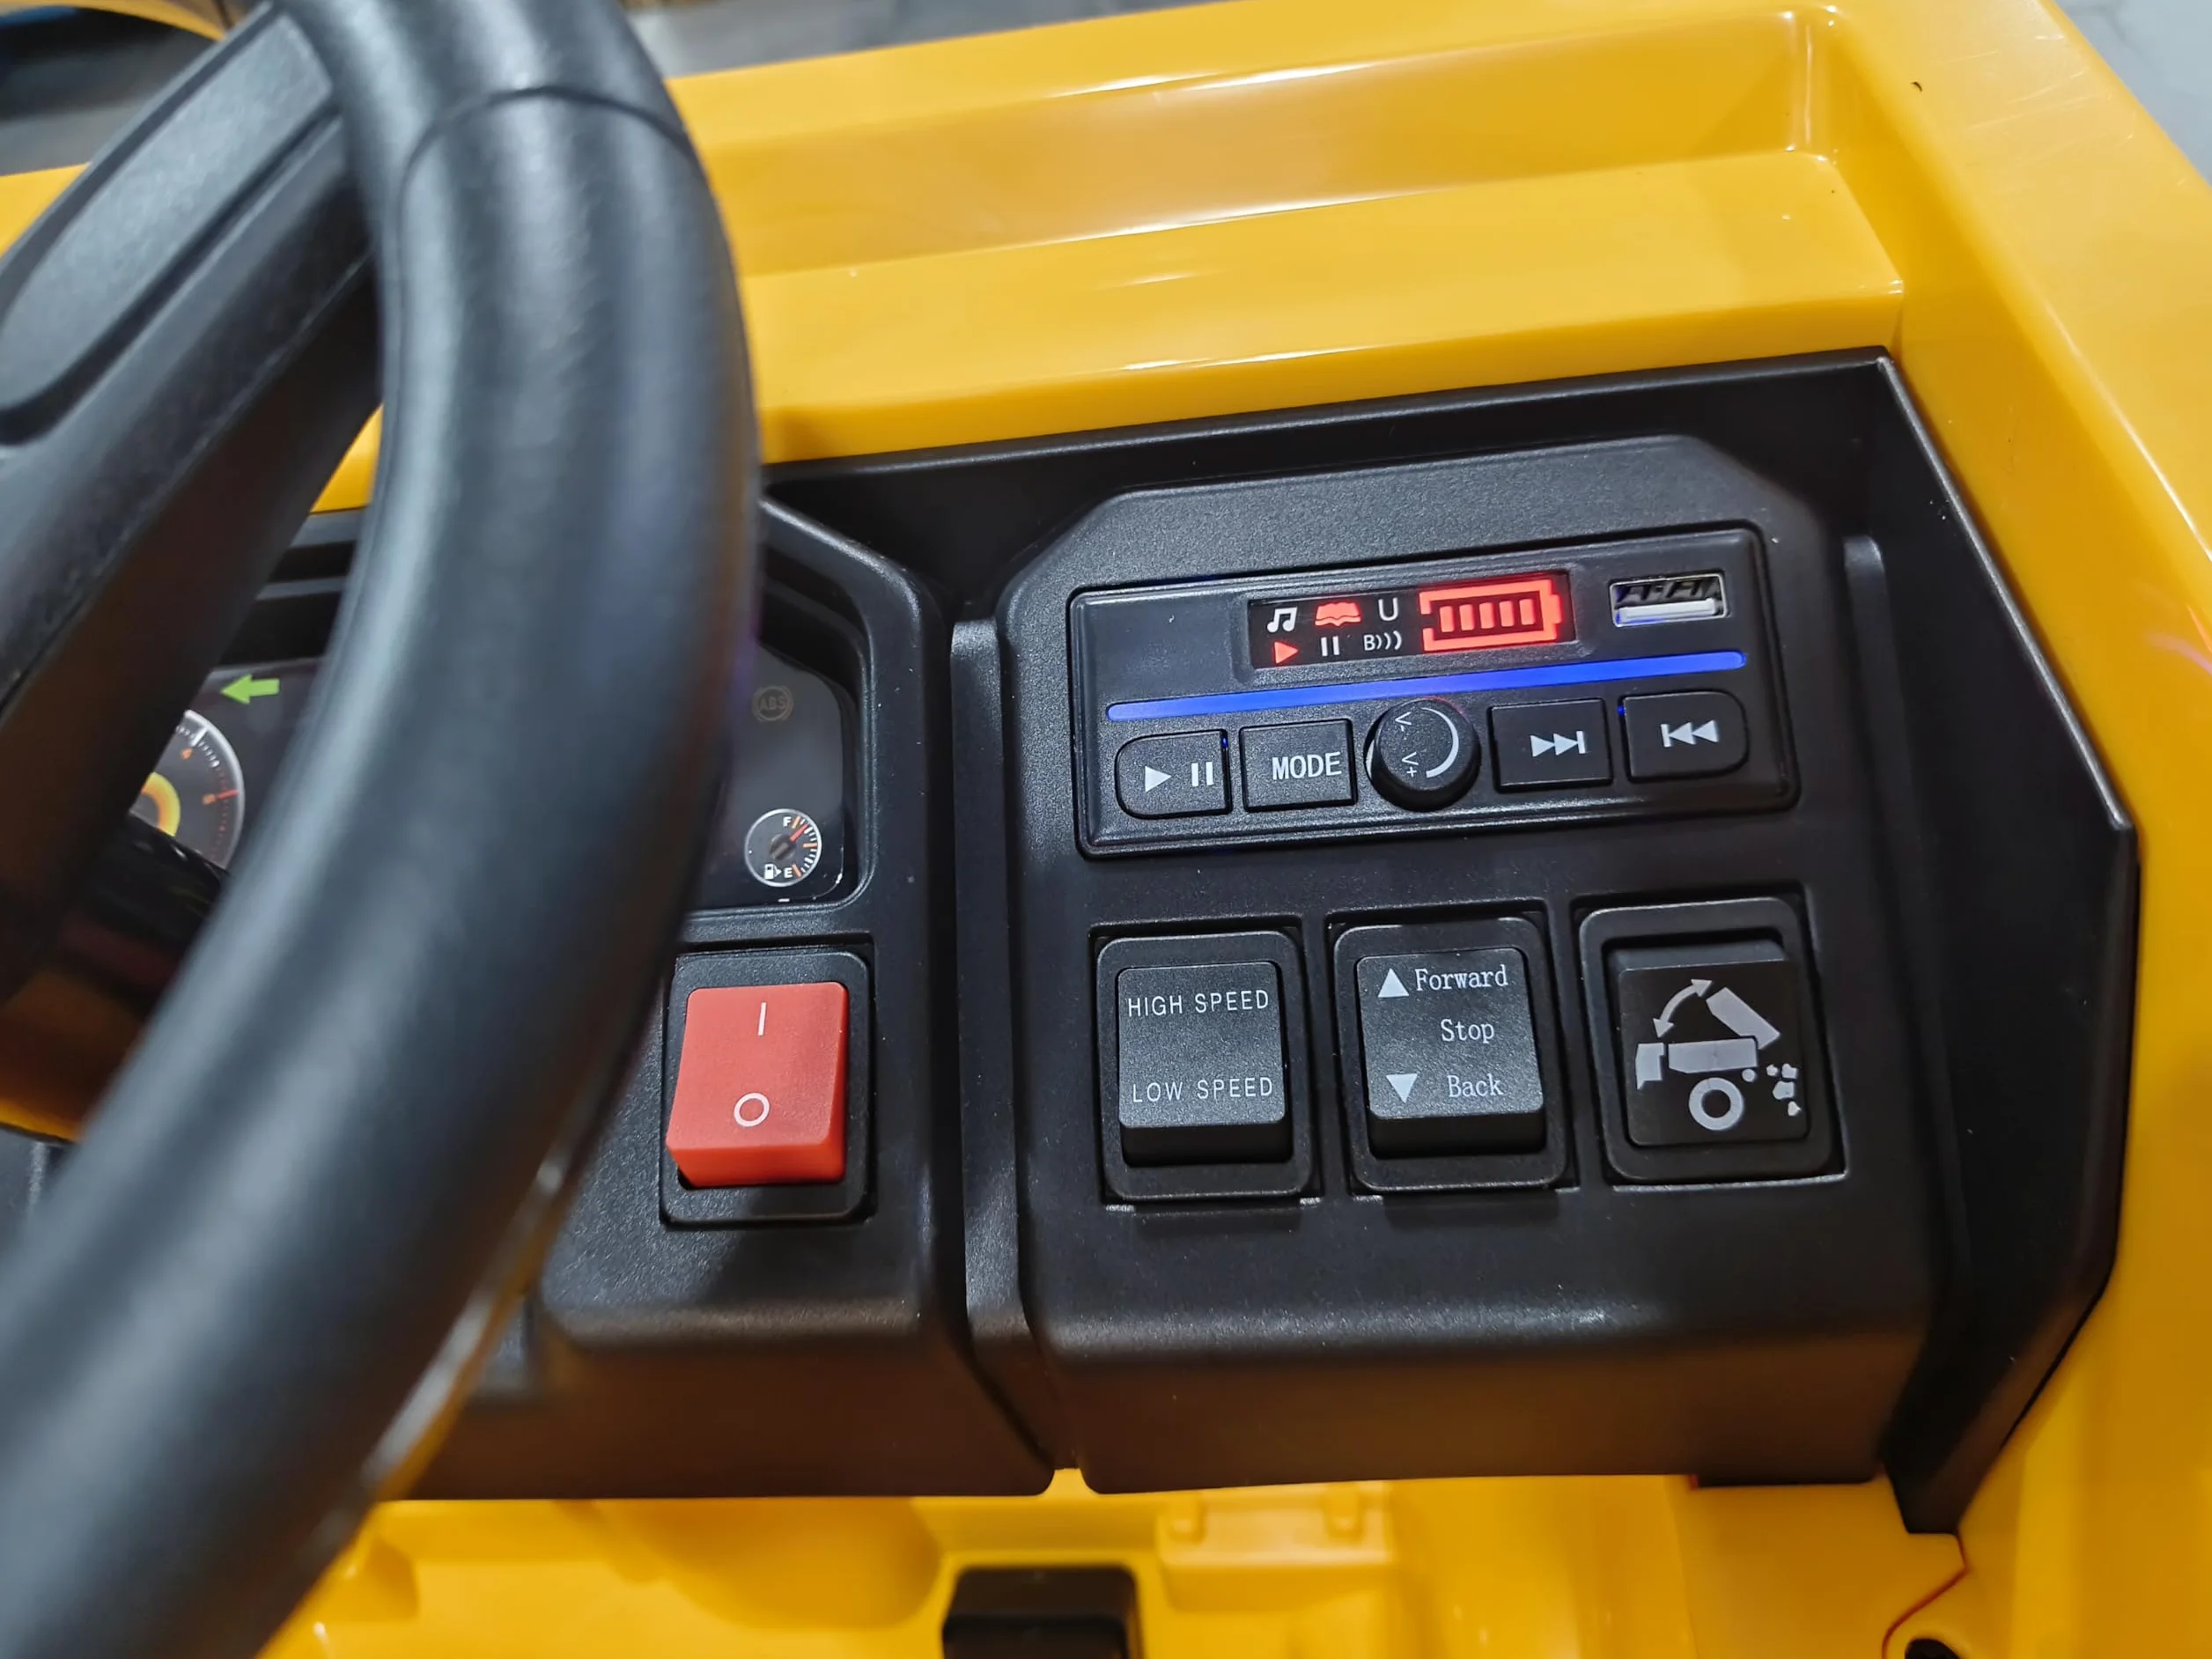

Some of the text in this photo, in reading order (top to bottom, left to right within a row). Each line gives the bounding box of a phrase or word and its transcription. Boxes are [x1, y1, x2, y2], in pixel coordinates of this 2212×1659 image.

[759, 695, 786, 711] ABS
[1272, 751, 1343, 780] MODE
[783, 816, 793, 827] F
[784, 866, 793, 879] E
[1414, 963, 1508, 992] Forward
[1128, 990, 1269, 1017] HIGH SPEED
[1440, 1018, 1495, 1044] Stop
[1132, 1077, 1273, 1103] LOW SPEED
[1447, 1073, 1504, 1098] Back
